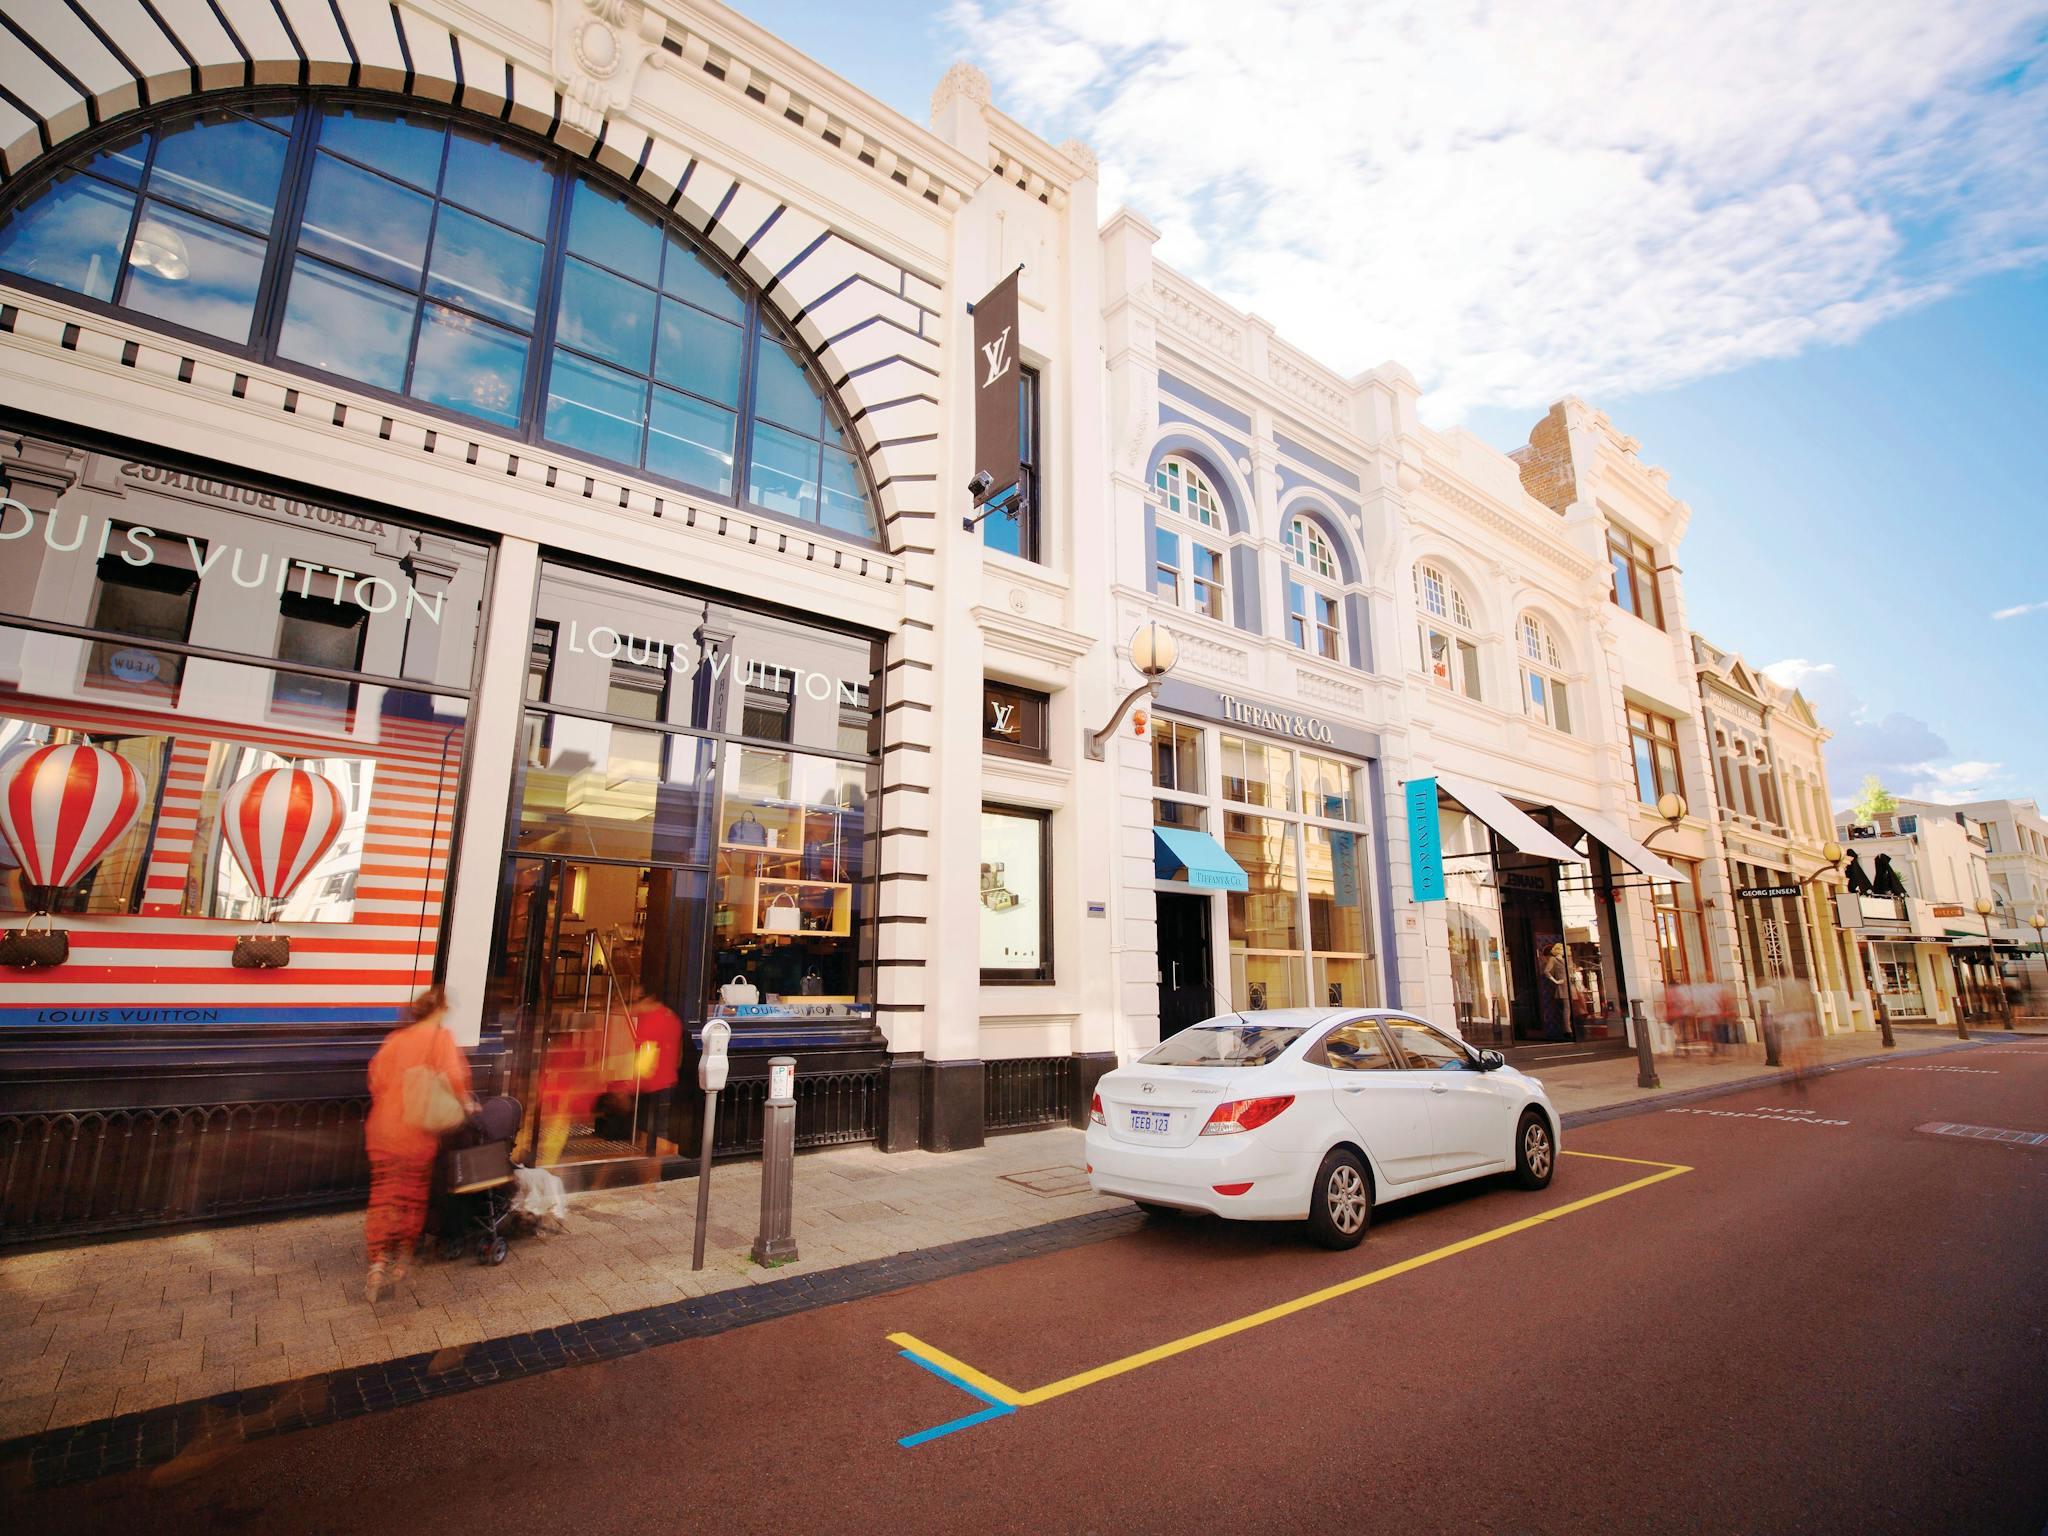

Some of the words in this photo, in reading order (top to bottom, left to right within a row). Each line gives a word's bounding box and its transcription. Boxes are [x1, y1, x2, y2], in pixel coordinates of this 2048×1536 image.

[0, 497, 156, 567] OUIS
[186, 537, 444, 625] VUITTON
[568, 620, 690, 673] LOUIS
[706, 649, 859, 708] VUITTON
[1220, 694, 1292, 734] TIFFANY
[1742, 889, 1768, 897] GEORG
[1769, 888, 1796, 896] JENSEN
[37, 1011, 109, 1023] LOUIS
[120, 1010, 218, 1022] VUITTON
[1155, 1120, 1169, 1132] 123
